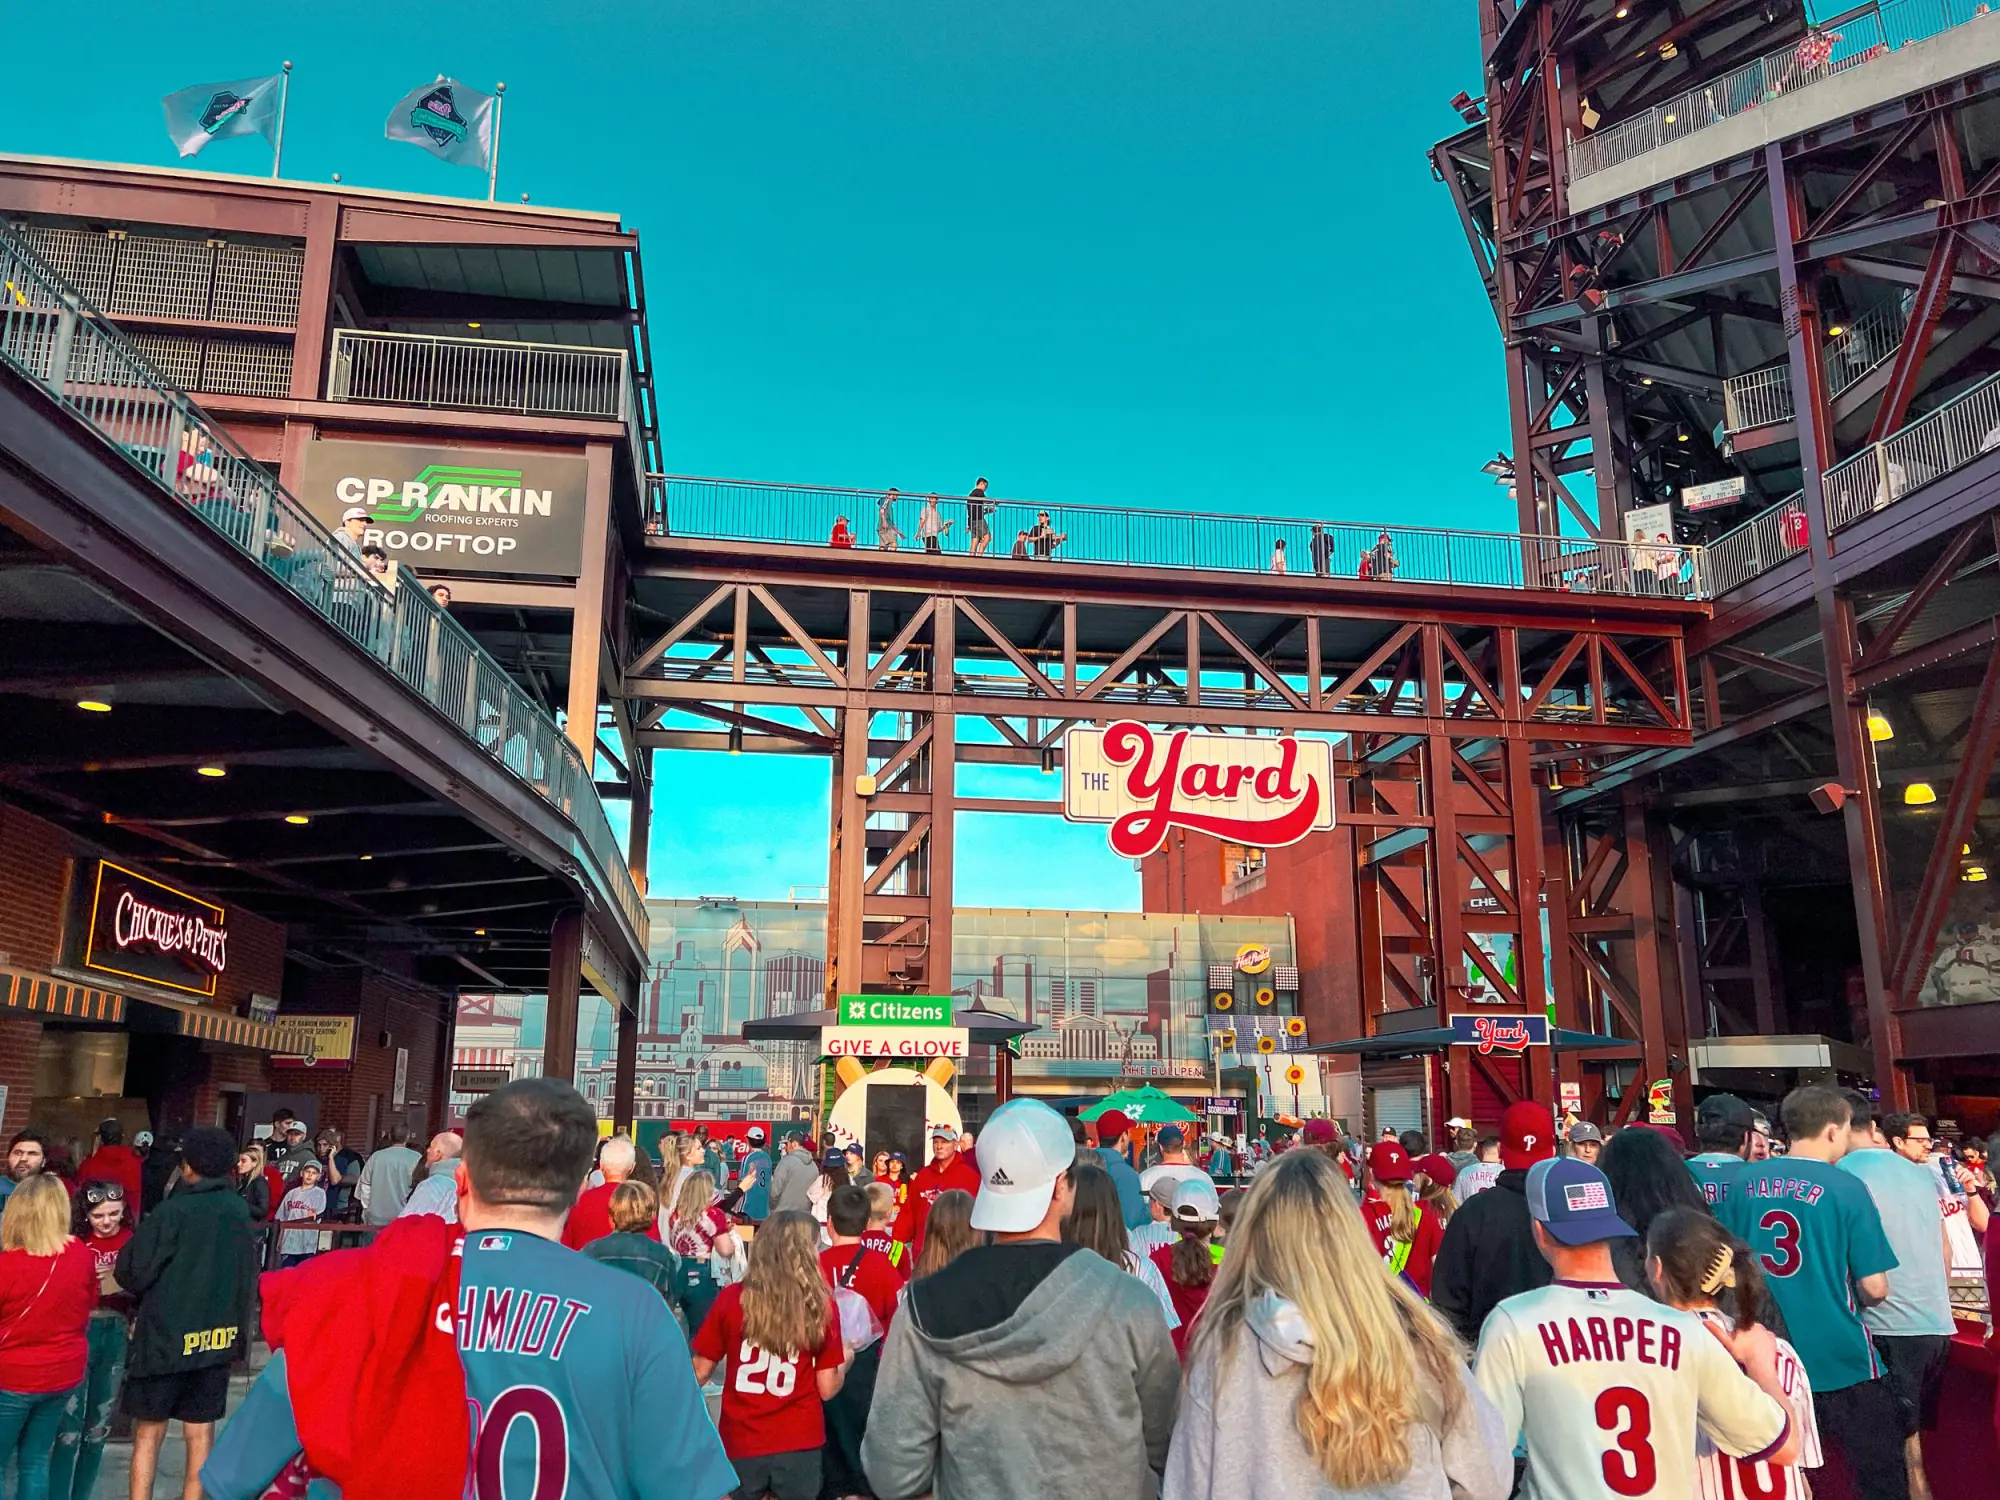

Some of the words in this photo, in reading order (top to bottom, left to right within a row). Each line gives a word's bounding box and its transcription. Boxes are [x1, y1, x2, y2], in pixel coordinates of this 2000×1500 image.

[336, 477, 394, 505] CP
[401, 482, 552, 517] RANKIN
[425, 513, 473, 525] ROOFING
[475, 516, 519, 528] EXPERTS
[363, 529, 517, 555] ROOFTOP
[1081, 772, 1109, 791] THE
[1102, 721, 1320, 857] Yard
[184, 919, 194, 949] &
[870, 1002, 943, 1020] Citizens
[828, 1040, 872, 1055] GIVE
[879, 1040, 892, 1055] A
[900, 1040, 961, 1056] GLOVE
[1475, 1018, 1530, 1055] Yard
[1123, 1065, 1146, 1076] THE
[1151, 1066, 1204, 1077] BULLPEN
[759, 1170, 766, 1187] 3
[1468, 1171, 1497, 1182] HARPE
[1746, 1177, 1825, 1206] HARPER
[1760, 1209, 1803, 1278] 3
[183, 1326, 238, 1355] PROF
[1538, 1317, 1682, 1371] HARPER
[736, 1339, 800, 1397] 26
[1595, 1386, 1657, 1497] 3
